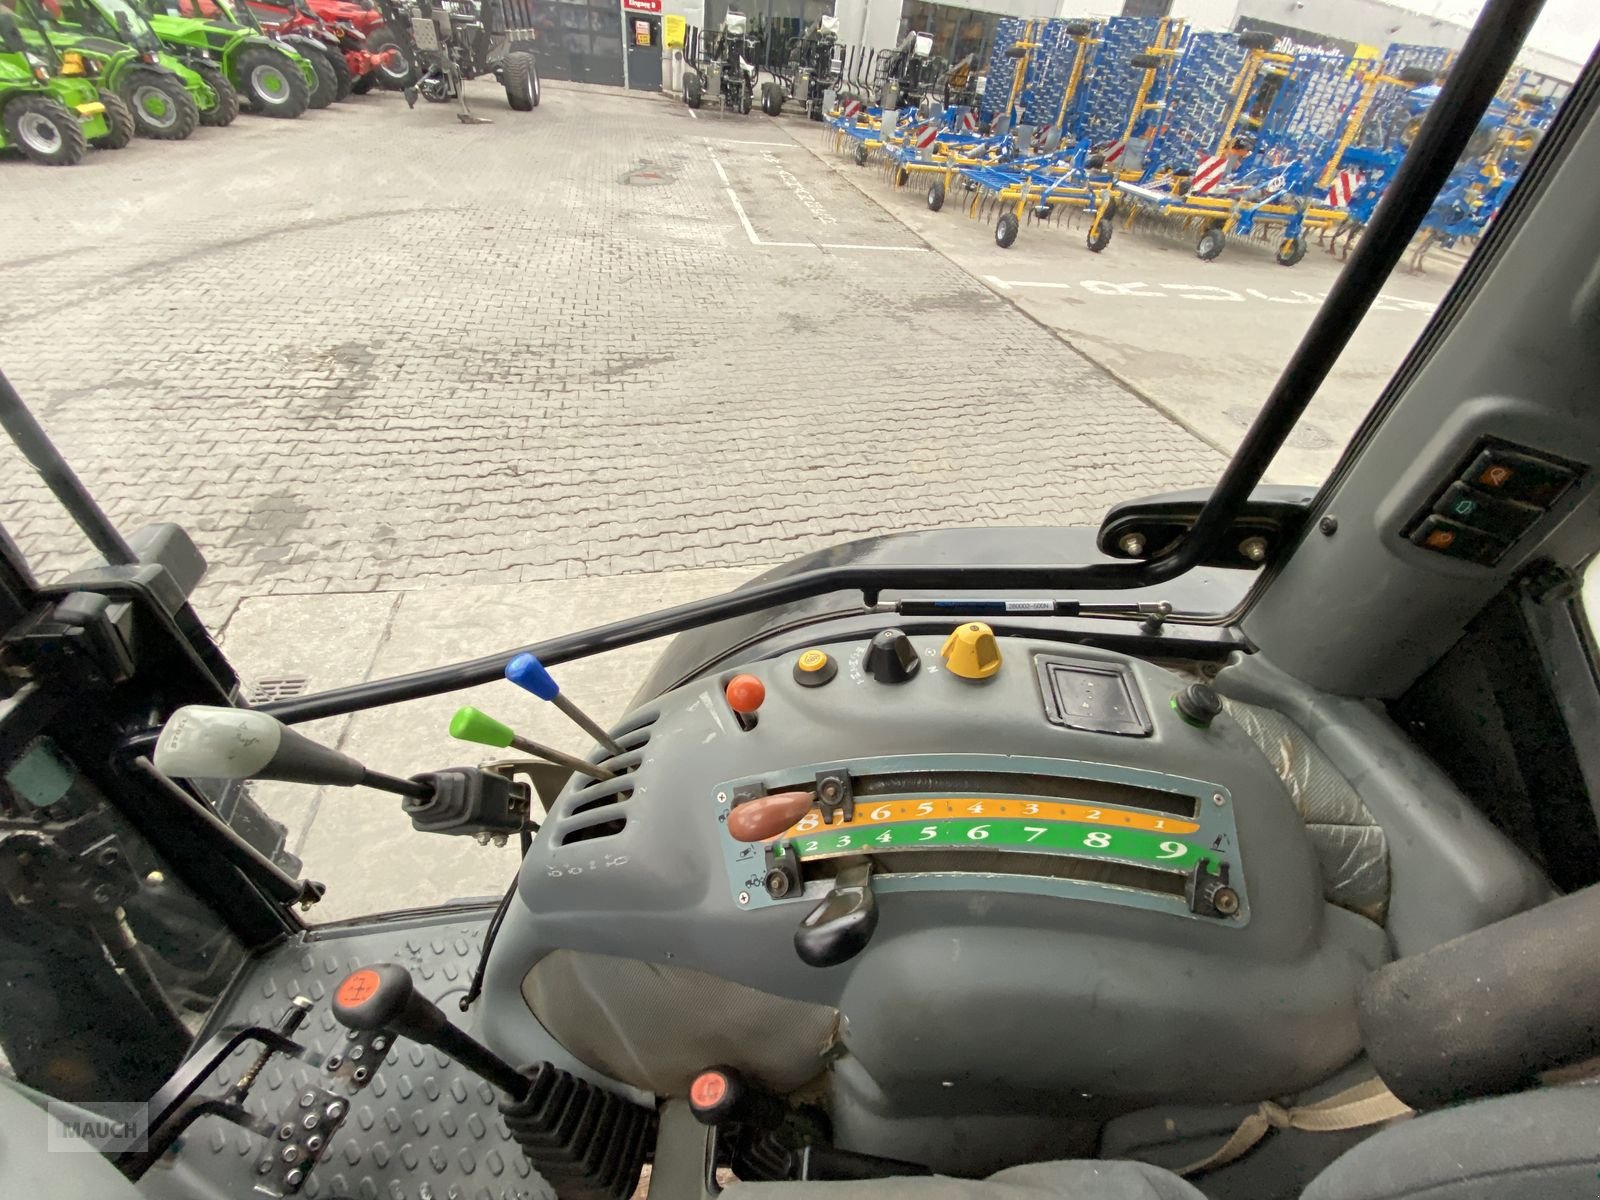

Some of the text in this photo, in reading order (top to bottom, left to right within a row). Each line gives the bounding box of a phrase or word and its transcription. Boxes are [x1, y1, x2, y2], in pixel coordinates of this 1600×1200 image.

[870, 804, 893, 820] 6
[916, 802, 934, 816] 5
[967, 801, 985, 814] 4
[1023, 803, 1040, 815] 3
[1086, 810, 1102, 820] 2
[1155, 820, 1166, 829] 1
[805, 841, 819, 852] 2
[836, 835, 851, 848] 3
[875, 829, 893, 843] 4
[918, 826, 938, 841] 5
[967, 824, 992, 840] 6
[1023, 826, 1049, 842] 7
[1083, 831, 1113, 848] 8
[1156, 841, 1188, 859] 9
